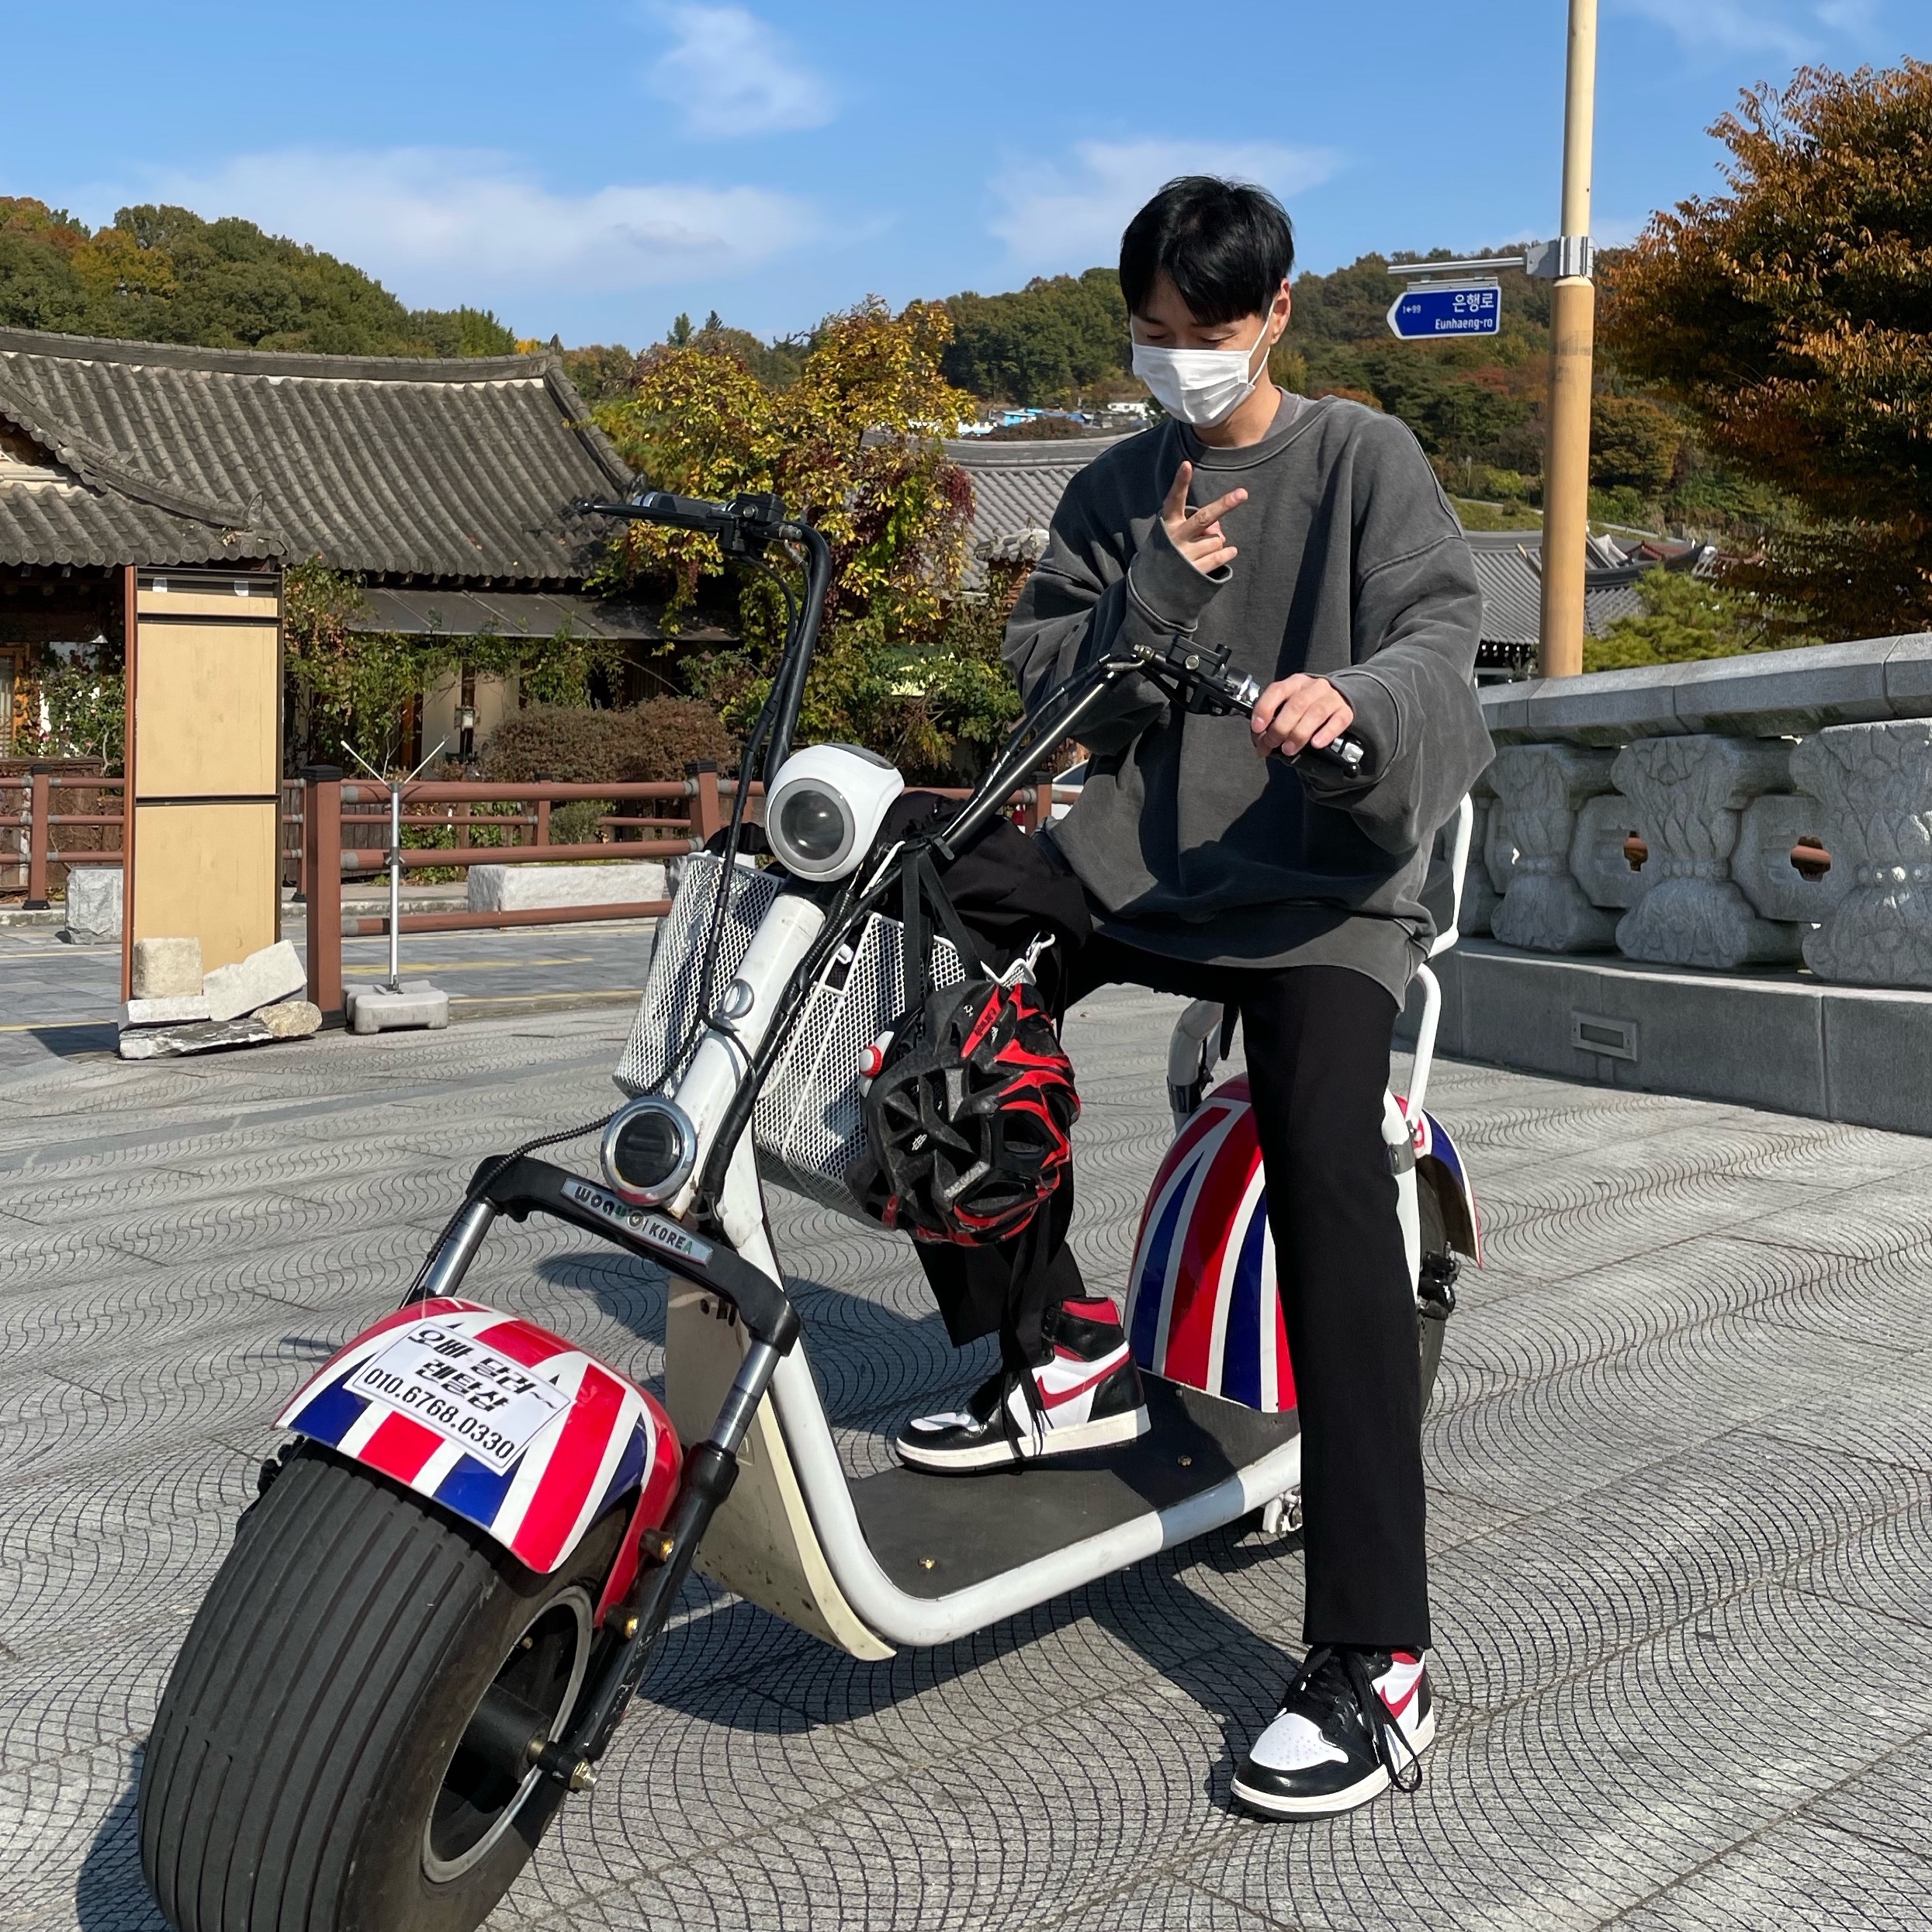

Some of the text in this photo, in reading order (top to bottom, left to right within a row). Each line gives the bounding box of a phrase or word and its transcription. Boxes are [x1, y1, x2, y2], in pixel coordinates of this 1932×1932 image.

[1452, 293, 1494, 313] 은행로
[1435, 318, 1493, 330] Eunhaeng-ro
[649, 1222, 693, 1255] KOREA
[408, 1330, 474, 1359] 오빠
[415, 1359, 509, 1411] 렌탈샵
[364, 1368, 515, 1459] 010.6768.0330
